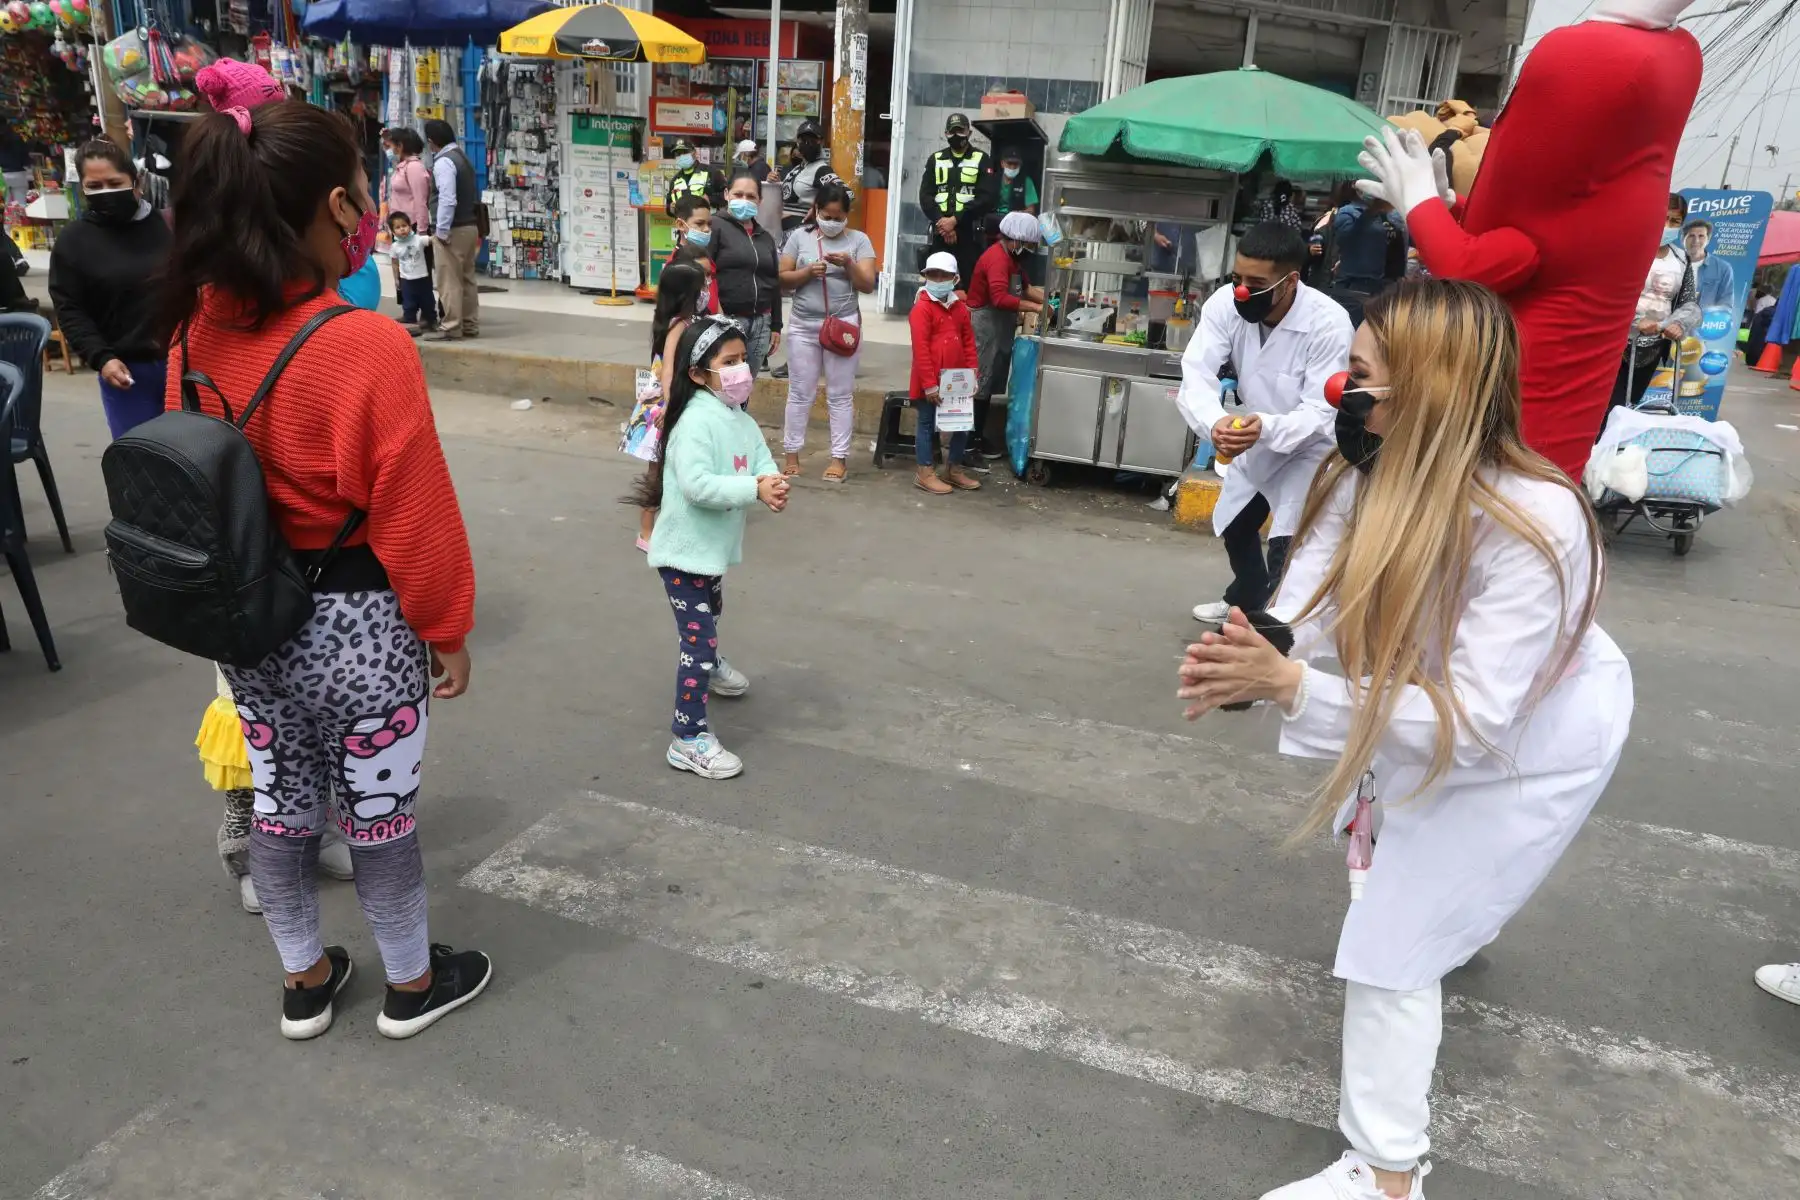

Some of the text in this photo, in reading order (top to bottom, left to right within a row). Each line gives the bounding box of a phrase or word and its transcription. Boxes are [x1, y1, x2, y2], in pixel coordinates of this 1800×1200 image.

[704, 30, 770, 47] ZONA BEB
[1688, 195, 1753, 213] Ensure
[1710, 208, 1750, 217] ADVANCE
[1701, 321, 1726, 330] HMB
